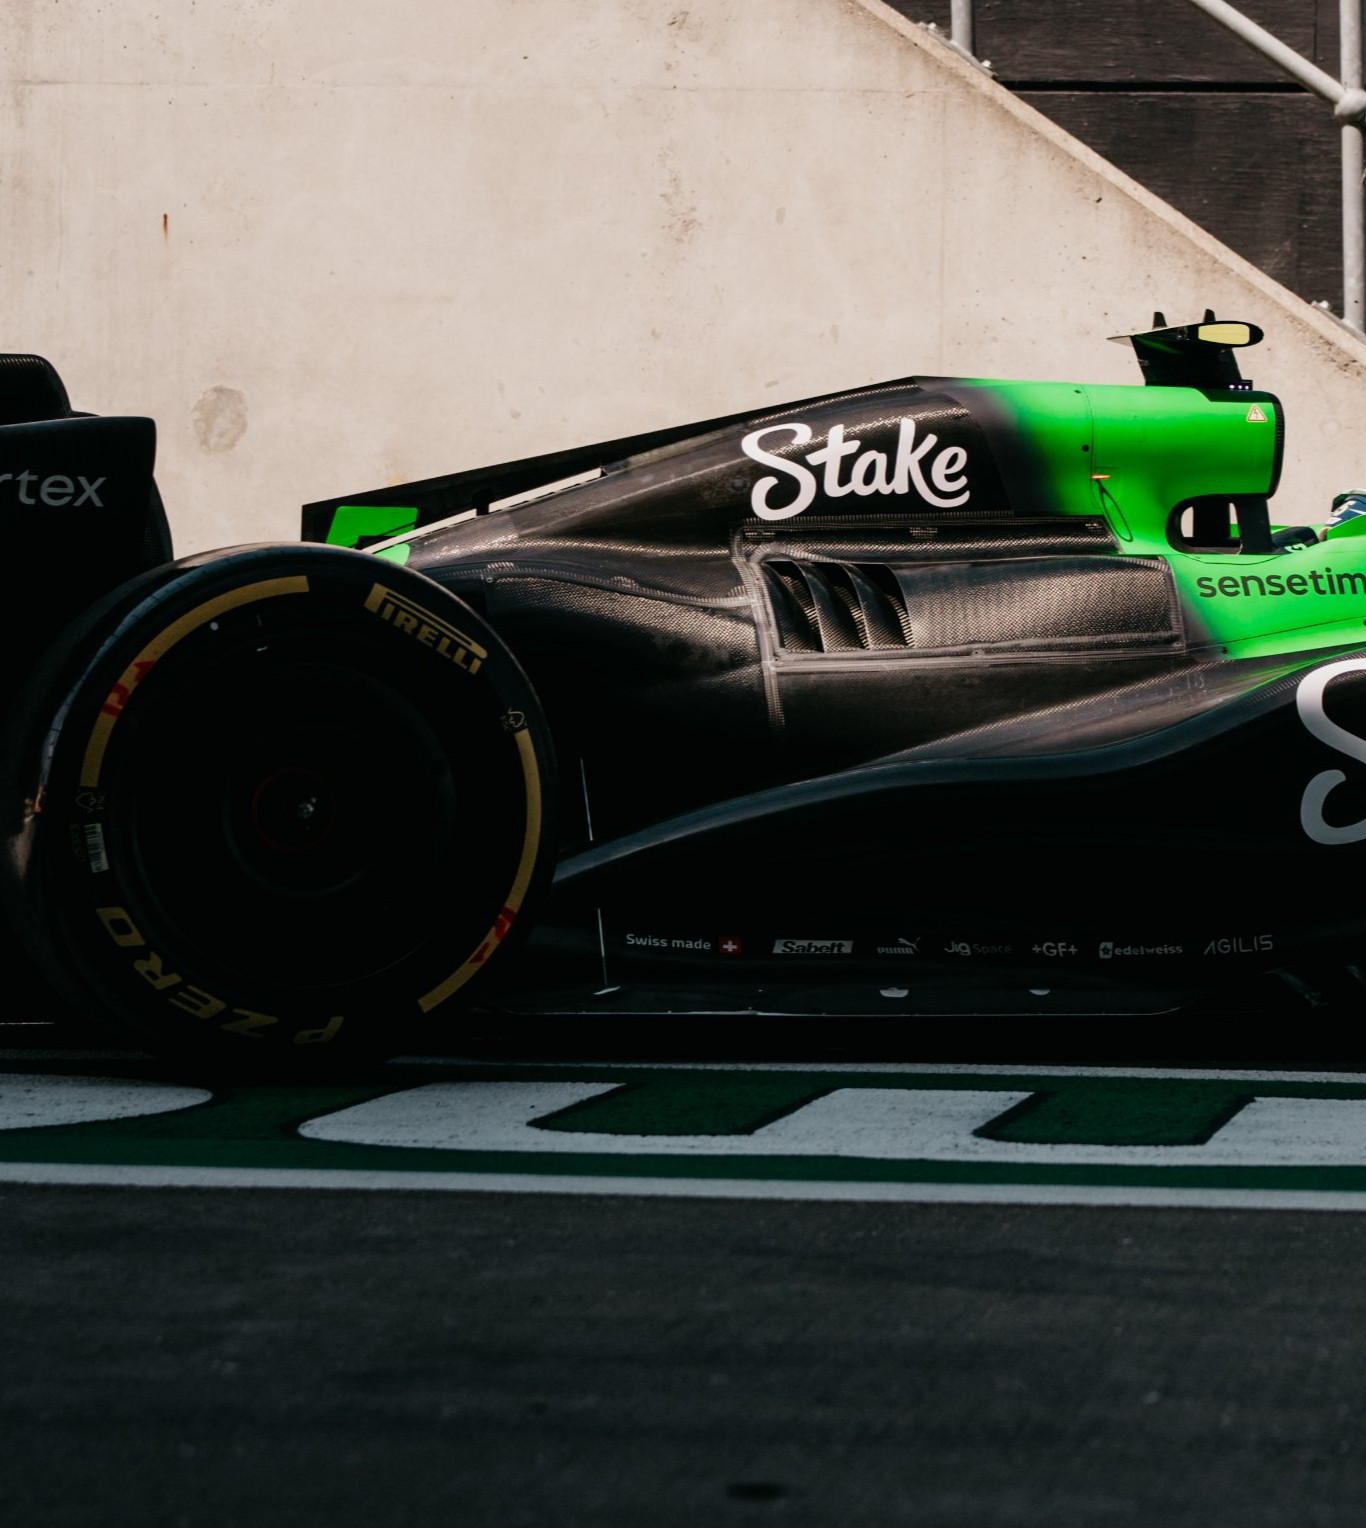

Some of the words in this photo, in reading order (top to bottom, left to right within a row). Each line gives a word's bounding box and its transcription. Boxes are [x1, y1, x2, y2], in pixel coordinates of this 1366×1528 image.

[742, 418, 970, 521] Stake
[364, 583, 487, 674] PIRELLI
[625, 933, 667, 948] Swiss
[671, 936, 712, 950] made
[782, 940, 845, 953] Sabelt
[1113, 942, 1183, 956] edelweiss
[95, 905, 280, 1039] ZERO
[291, 1015, 345, 1045] P
